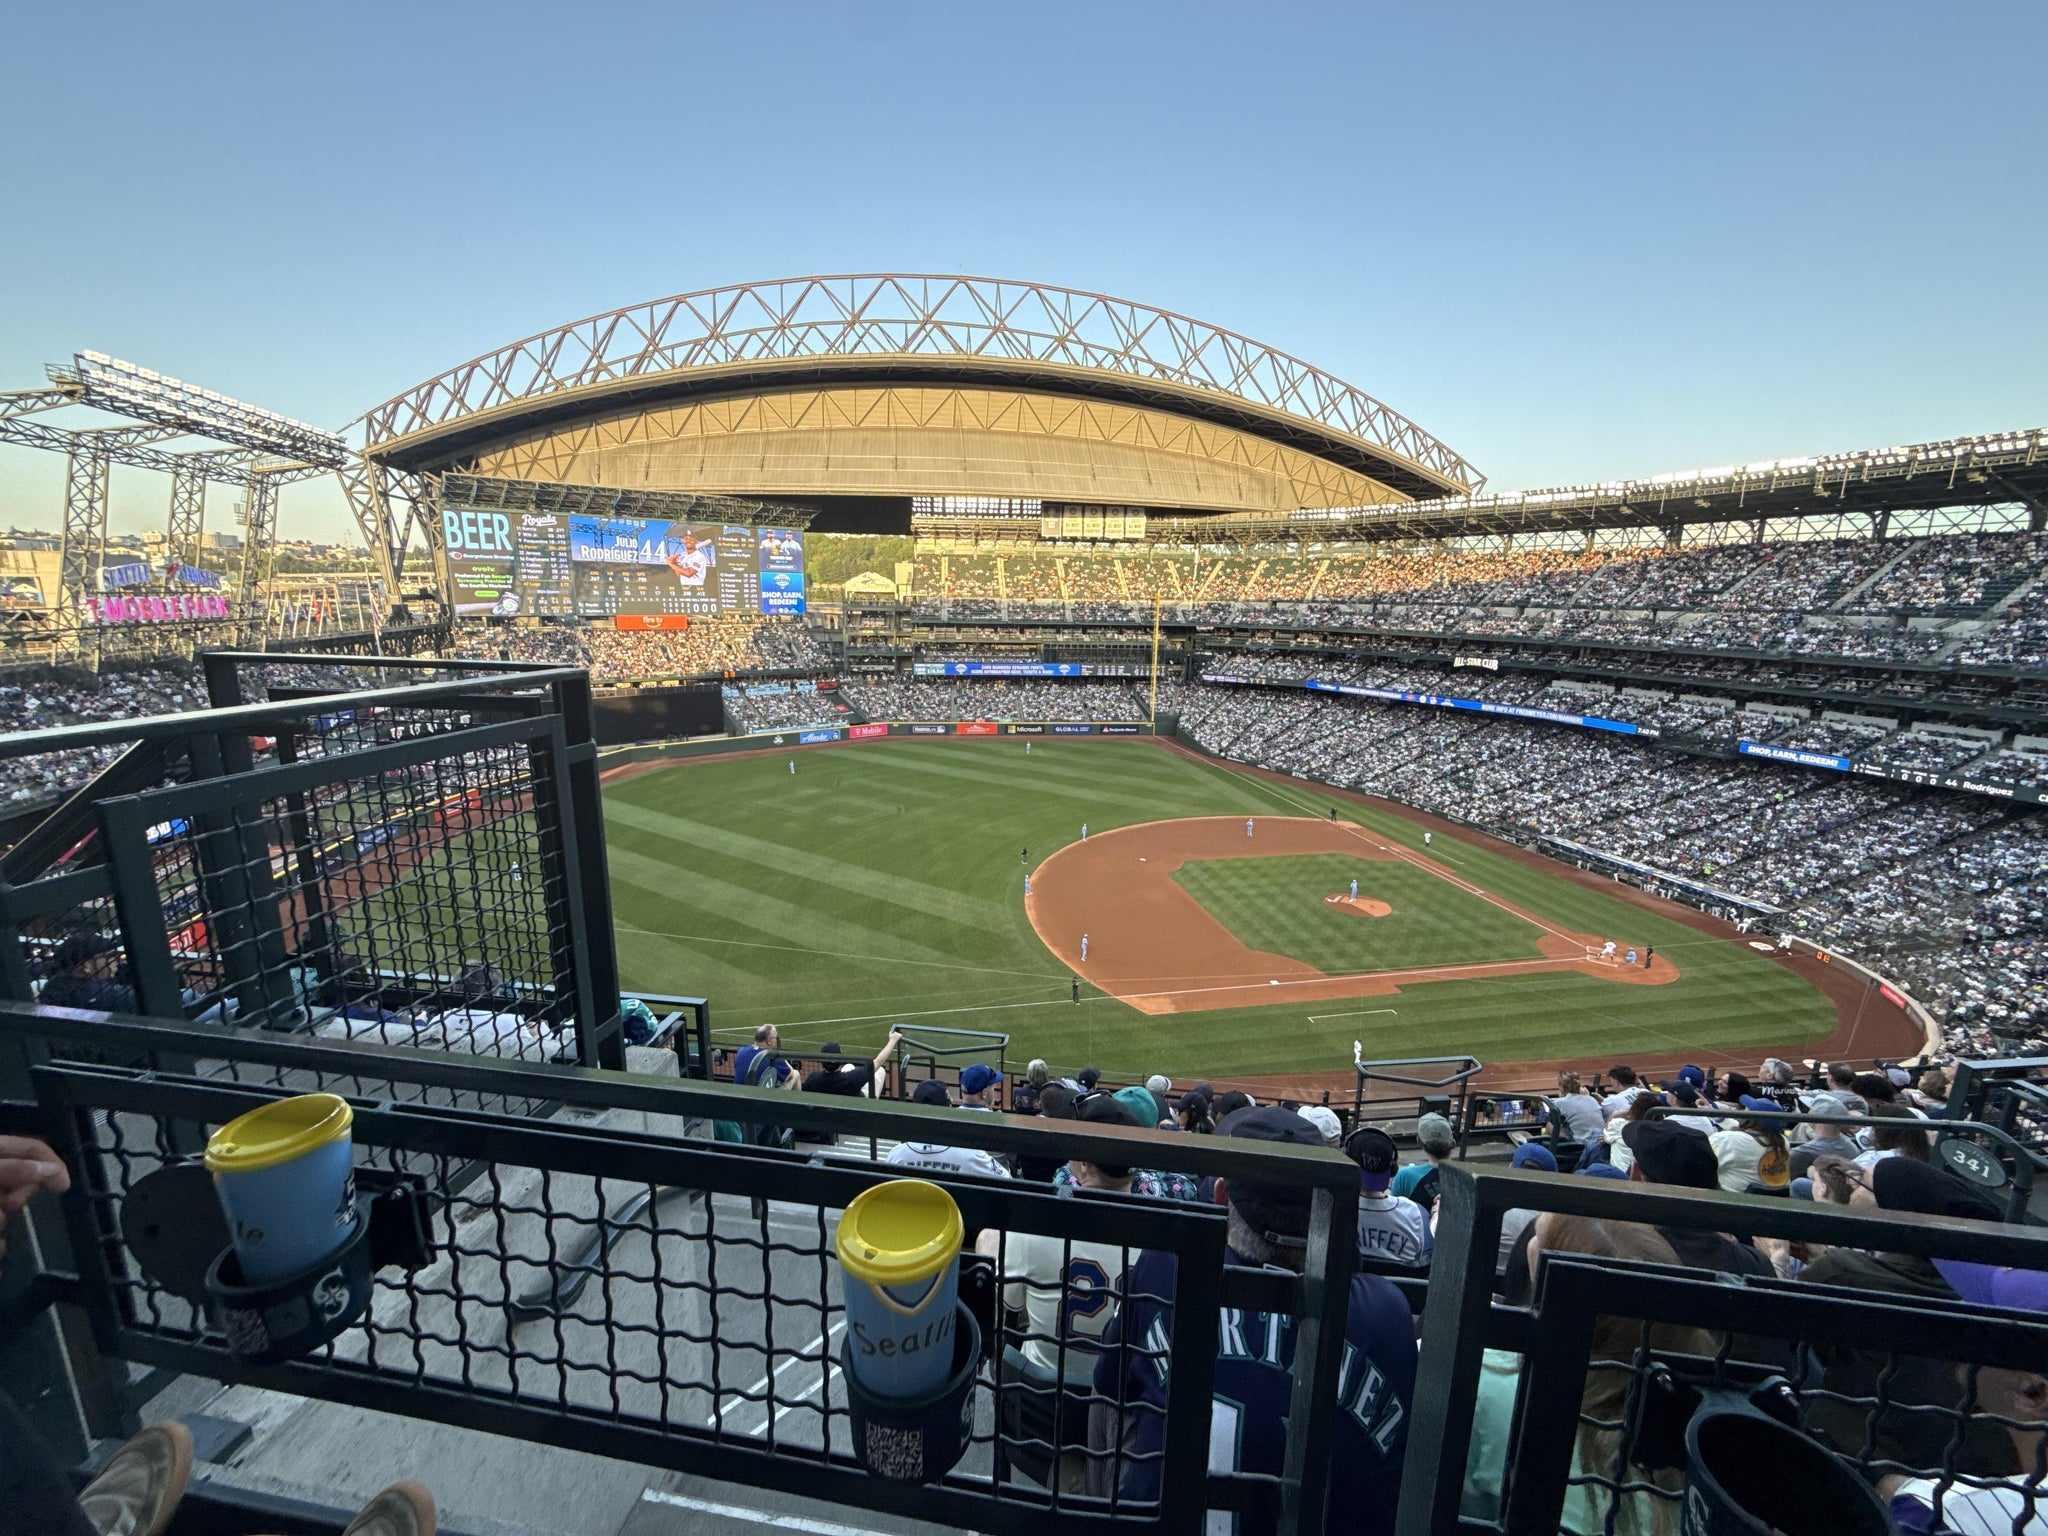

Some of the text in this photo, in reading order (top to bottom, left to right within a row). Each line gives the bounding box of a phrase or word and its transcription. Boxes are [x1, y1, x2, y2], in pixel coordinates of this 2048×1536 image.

[522, 514, 557, 526] Royals
[443, 510, 513, 550] BEER
[614, 536, 638, 548] JULIO
[581, 545, 638, 561] RODRÍGUEZ
[640, 540, 667, 560] 44
[762, 592, 782, 600] SHOP,
[87, 596, 230, 622] T-MOBILE PARK
[693, 604, 717, 612] 0 0 0
[1453, 657, 1498, 670] ALL-STAR CLUB
[802, 734, 828, 743] Alaska
[1748, 746, 1839, 767] SHOP, EARN, REDEEM!
[1963, 781, 2013, 796] Rodríguez
[1953, 1150, 1990, 1178] 341
